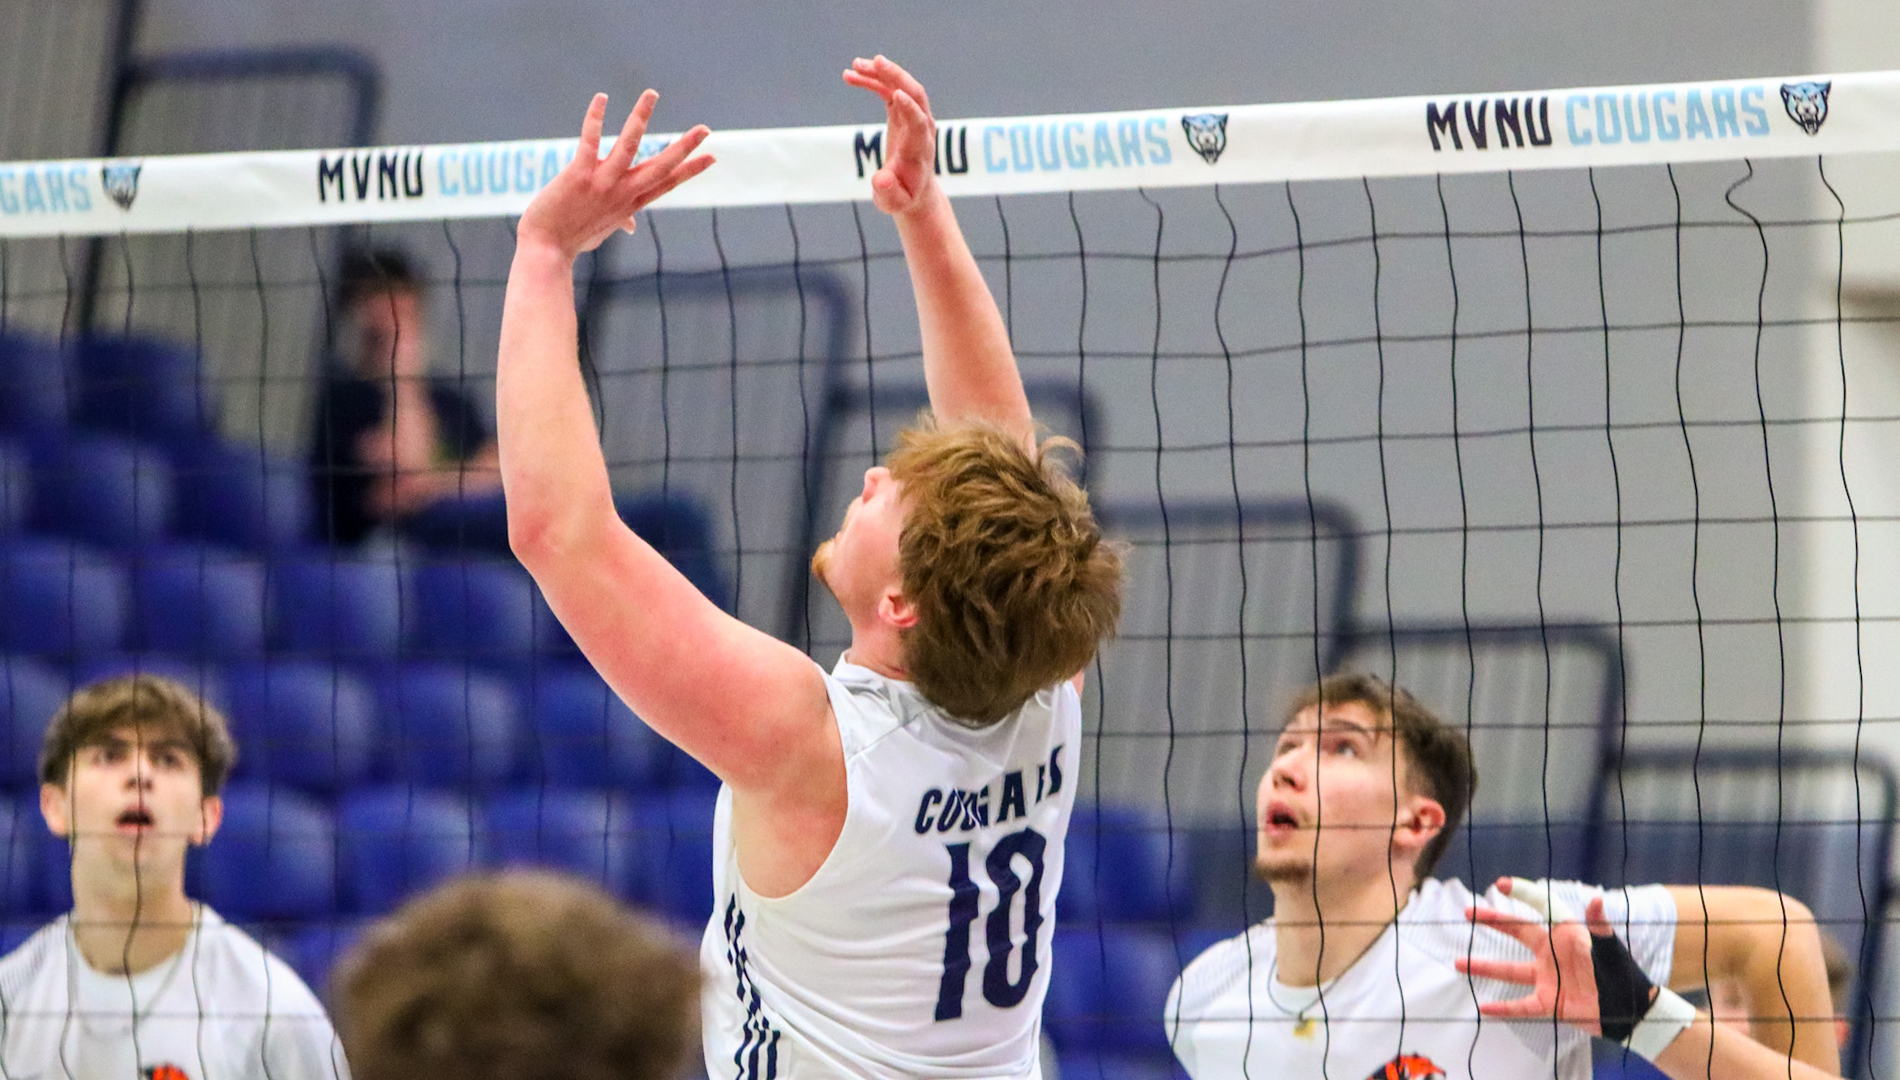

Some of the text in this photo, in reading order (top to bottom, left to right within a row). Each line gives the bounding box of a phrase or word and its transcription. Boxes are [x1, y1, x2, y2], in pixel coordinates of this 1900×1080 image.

[982, 117, 1173, 174] COUGARS
[1425, 84, 1771, 151] MVNU COUGARS
[318, 151, 424, 203] MVNU
[934, 827, 1047, 1021] 10
